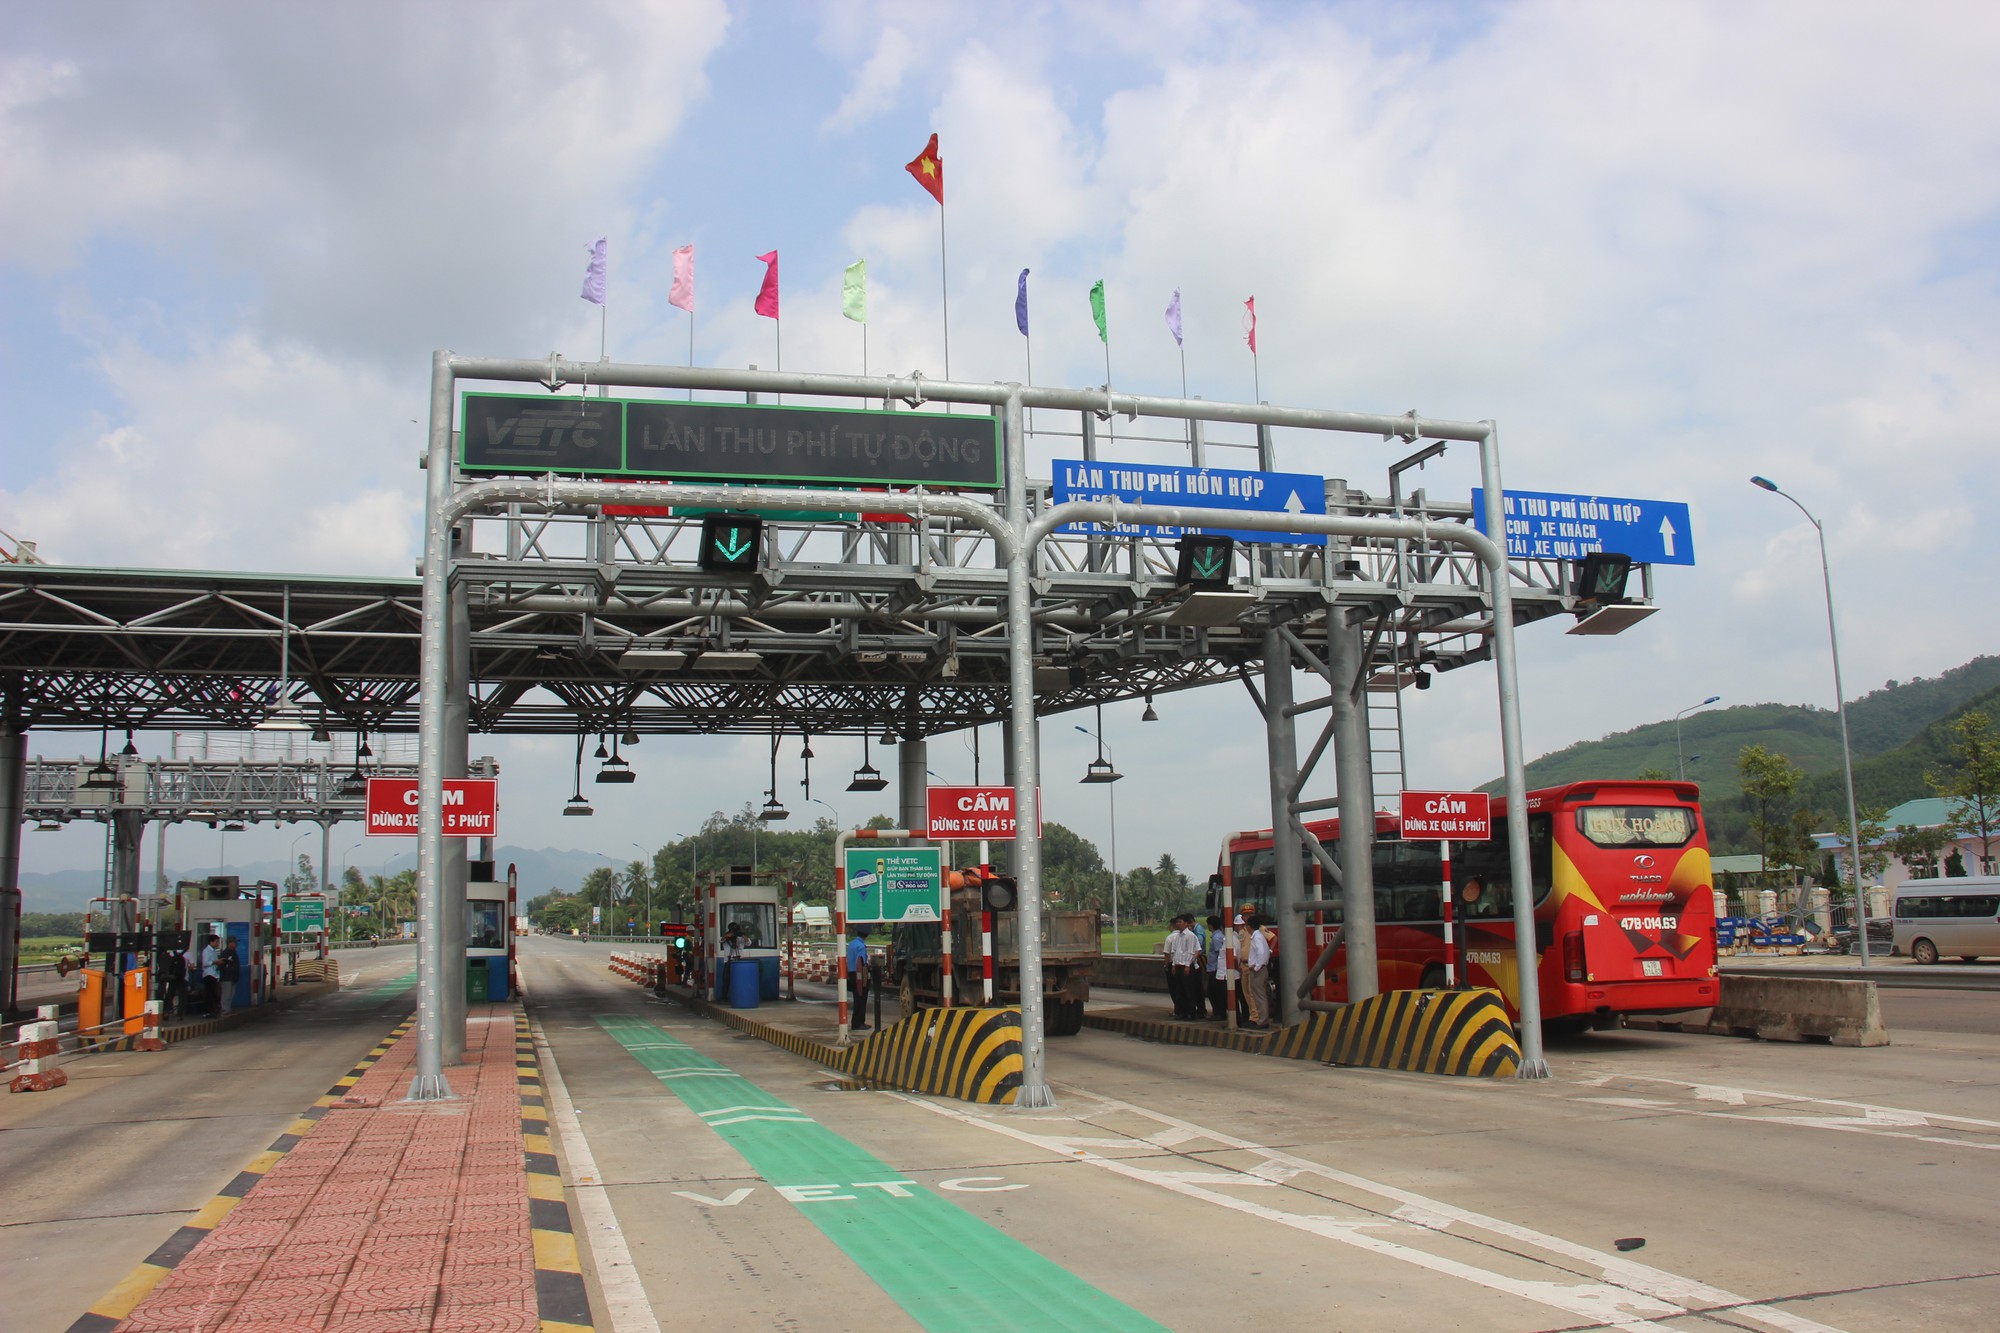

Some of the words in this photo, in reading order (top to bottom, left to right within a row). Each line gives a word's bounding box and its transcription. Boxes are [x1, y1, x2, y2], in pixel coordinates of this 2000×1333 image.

[486, 412, 602, 451] VETC
[643, 417, 705, 452] LÀN
[714, 426, 776, 454] THU
[787, 424, 840, 457] PHÍ
[845, 432, 886, 465] TỰ
[891, 429, 981, 468] ĐỘNG
[1066, 465, 1103, 489] LÀN
[1110, 470, 1143, 491] THU
[1147, 471, 1179, 493] PHÍ
[1186, 468, 1223, 496] HỖN
[1229, 477, 1264, 501] HỢP
[1518, 498, 1548, 516] THU
[1550, 498, 1577, 519] PHÍ
[1579, 496, 1610, 521] HỖN
[1612, 503, 1642, 526] HỢP
[1505, 519, 1530, 535] CON
[1540, 521, 1557, 537] XE
[1559, 521, 1597, 539] KHÁCH
[1506, 535, 1527, 554] TẢI
[1553, 540, 1577, 558] QUÁ
[403, 789, 464, 806] CM
[957, 792, 1010, 812] CẤM
[1425, 794, 1467, 815] CẤM
[371, 810, 403, 827] DỪNG
[405, 815, 418, 827] XE
[448, 815, 456, 828] 5
[459, 811, 491, 828] PHÚT
[931, 816, 960, 832] DỪNG
[962, 819, 976, 831] XE
[977, 816, 999, 833] QUÁ
[1001, 819, 1008, 831] 5
[1404, 816, 1428, 831] DỪNG
[1429, 820, 1440, 831] XE
[1441, 818, 1457, 833] QUÁ
[1459, 820, 1465, 831] 5
[1466, 818, 1487, 832] PHÚT
[1591, 817, 1627, 833] HUY
[670, 1177, 1029, 1207] VETC
